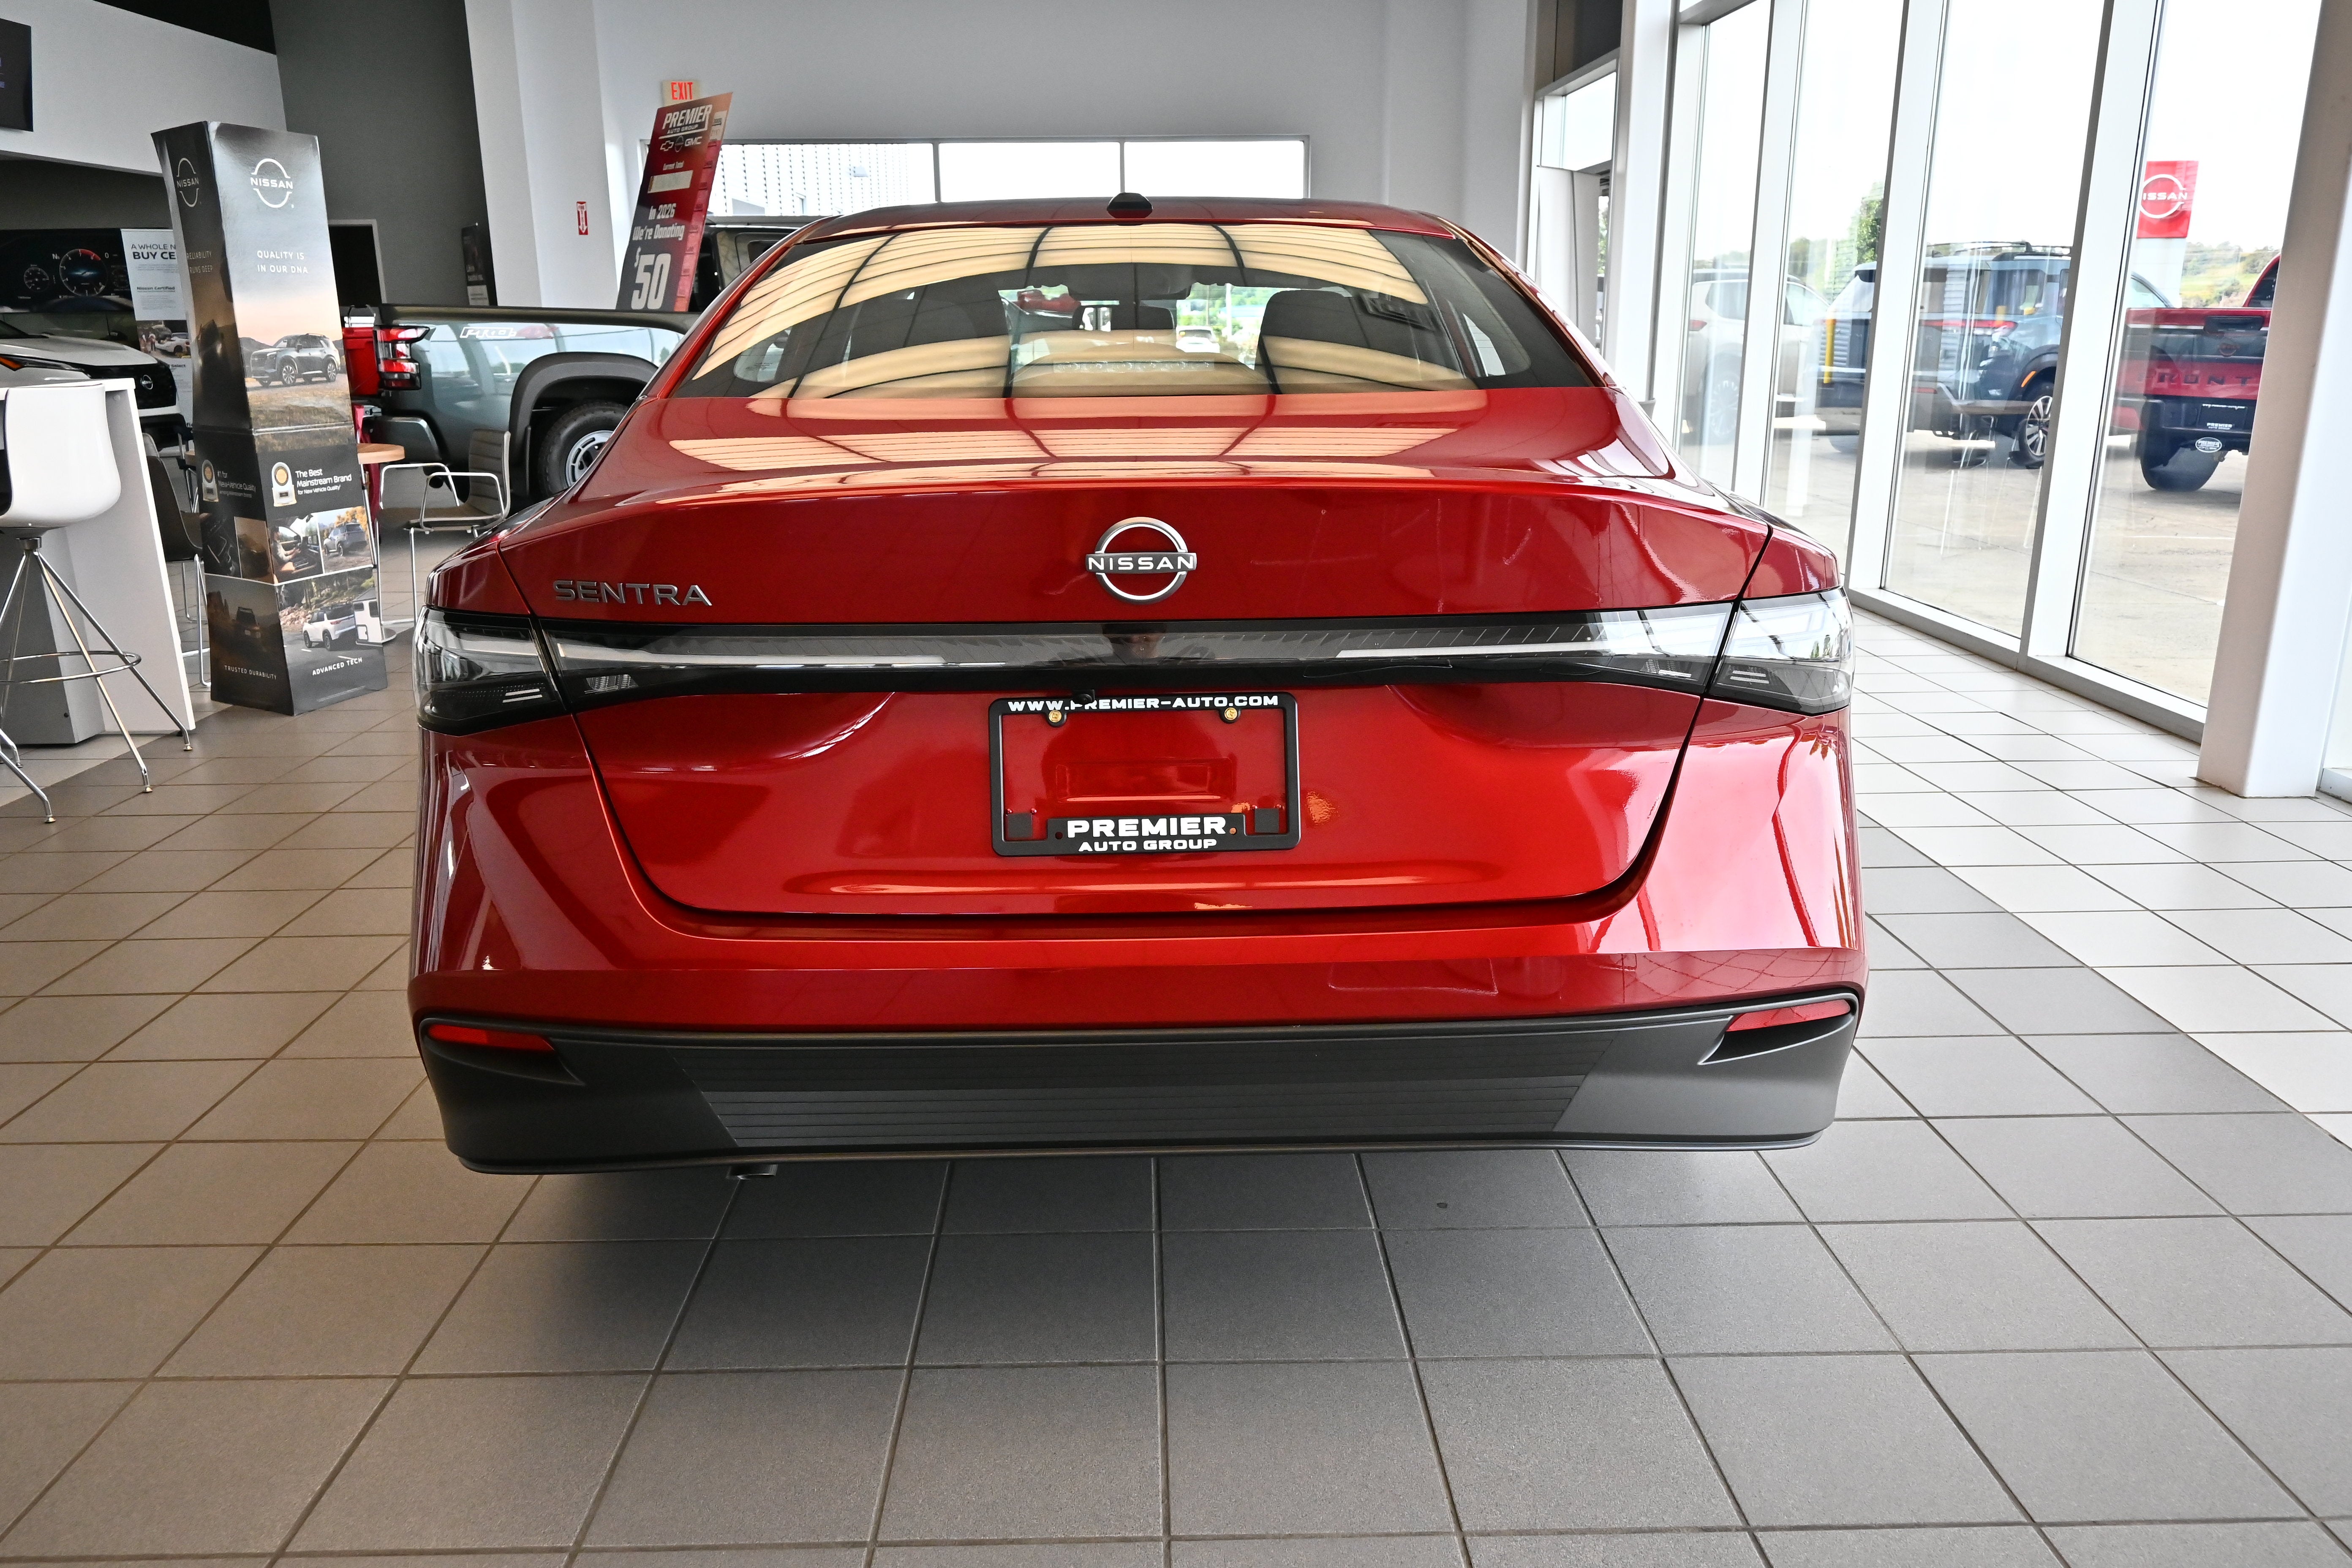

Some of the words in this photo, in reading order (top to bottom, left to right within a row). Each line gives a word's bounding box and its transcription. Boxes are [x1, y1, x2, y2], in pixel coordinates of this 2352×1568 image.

[670, 82, 693, 100] EXIT
[662, 104, 713, 130] PREMIER
[681, 124, 699, 132] GROUP
[684, 136, 702, 147] GMC
[176, 177, 199, 188] NISSAN
[250, 177, 294, 189] NISSAN
[2142, 192, 2188, 201] ISSAN
[648, 206, 656, 220] In
[656, 203, 677, 219] 2026
[632, 226, 654, 241] We're
[653, 222, 685, 241] Donating
[133, 251, 158, 260] BUY
[160, 251, 176, 260] CE
[186, 250, 212, 260] RELIABILITY
[256, 250, 294, 259] QUALITY
[189, 266, 201, 274] RUNS
[201, 265, 213, 273] DEEP
[257, 264, 266, 272] IN
[270, 264, 288, 273] OUR
[290, 265, 308, 274] DNA
[295, 470, 308, 478] The
[308, 468, 323, 477] Best
[297, 477, 333, 487] Mainstream
[333, 474, 352, 483] Brand
[1088, 555, 1194, 571] NISSAN
[553, 580, 713, 606] SENTRA
[224, 665, 248, 675] TRUSTED
[249, 670, 277, 680] DURABILITY
[312, 662, 345, 676] ADVANCED
[346, 657, 363, 667] TECH
[1067, 816, 1226, 838] PREMIER
[1078, 840, 1137, 852] AUTO
[1143, 838, 1217, 851] GROUP
